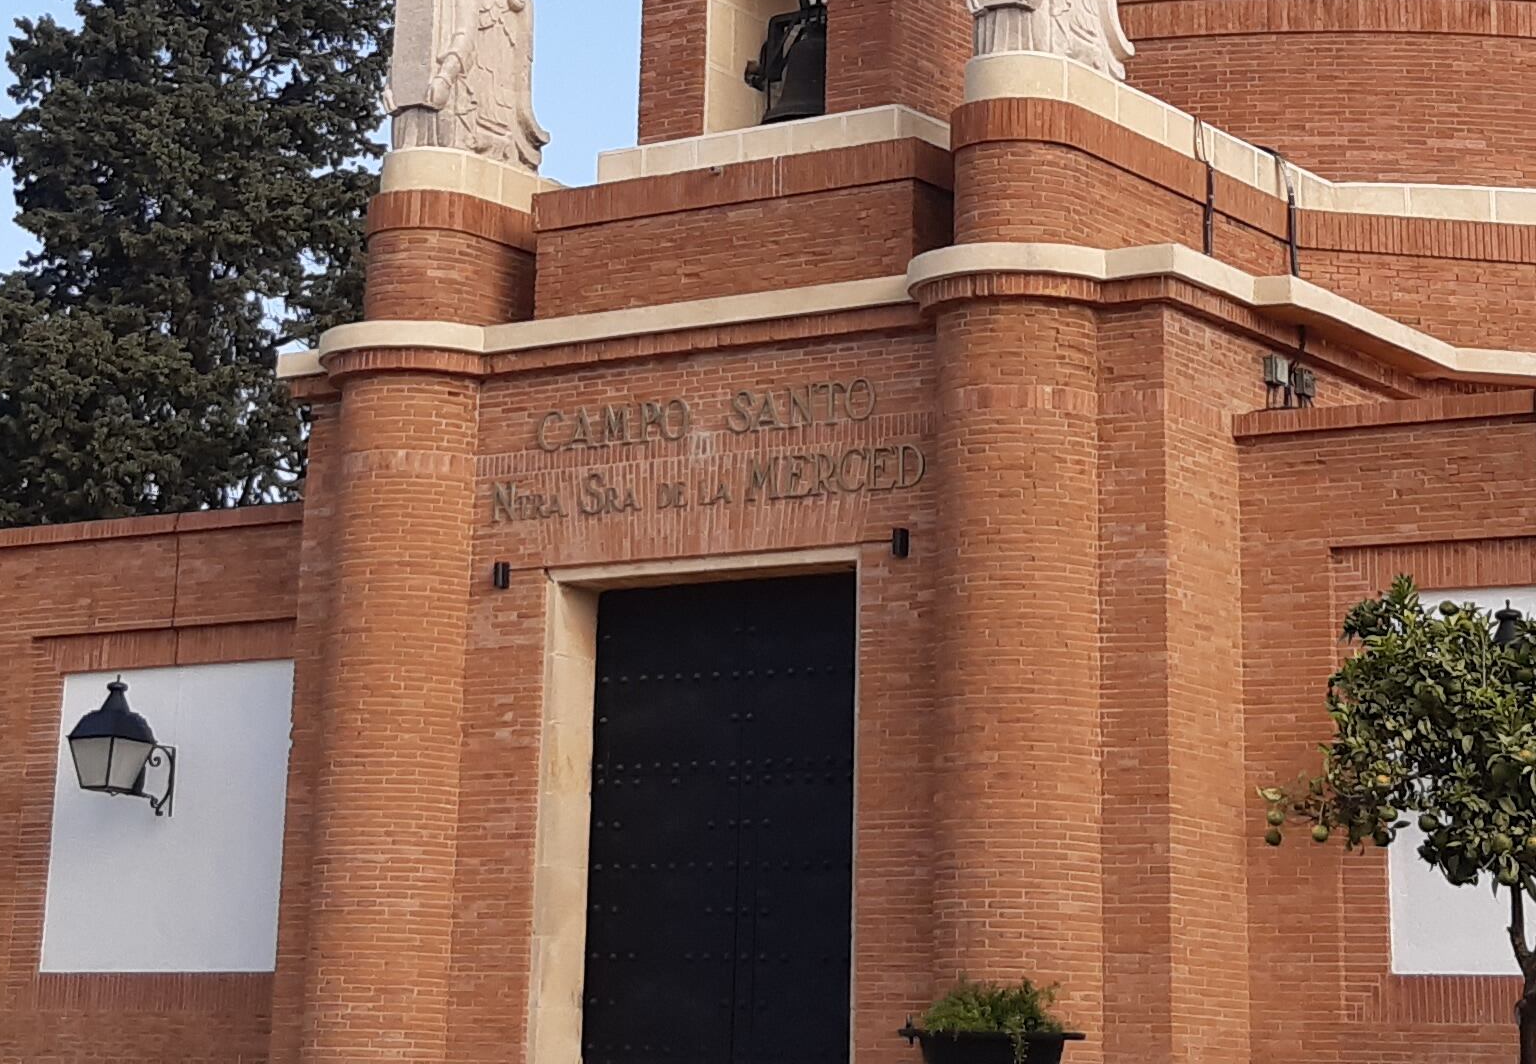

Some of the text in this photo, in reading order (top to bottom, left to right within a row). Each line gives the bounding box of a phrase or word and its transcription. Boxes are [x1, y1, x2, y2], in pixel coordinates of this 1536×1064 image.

[537, 377, 877, 453] CAMPO SANTO
[744, 443, 926, 502] MERCED
